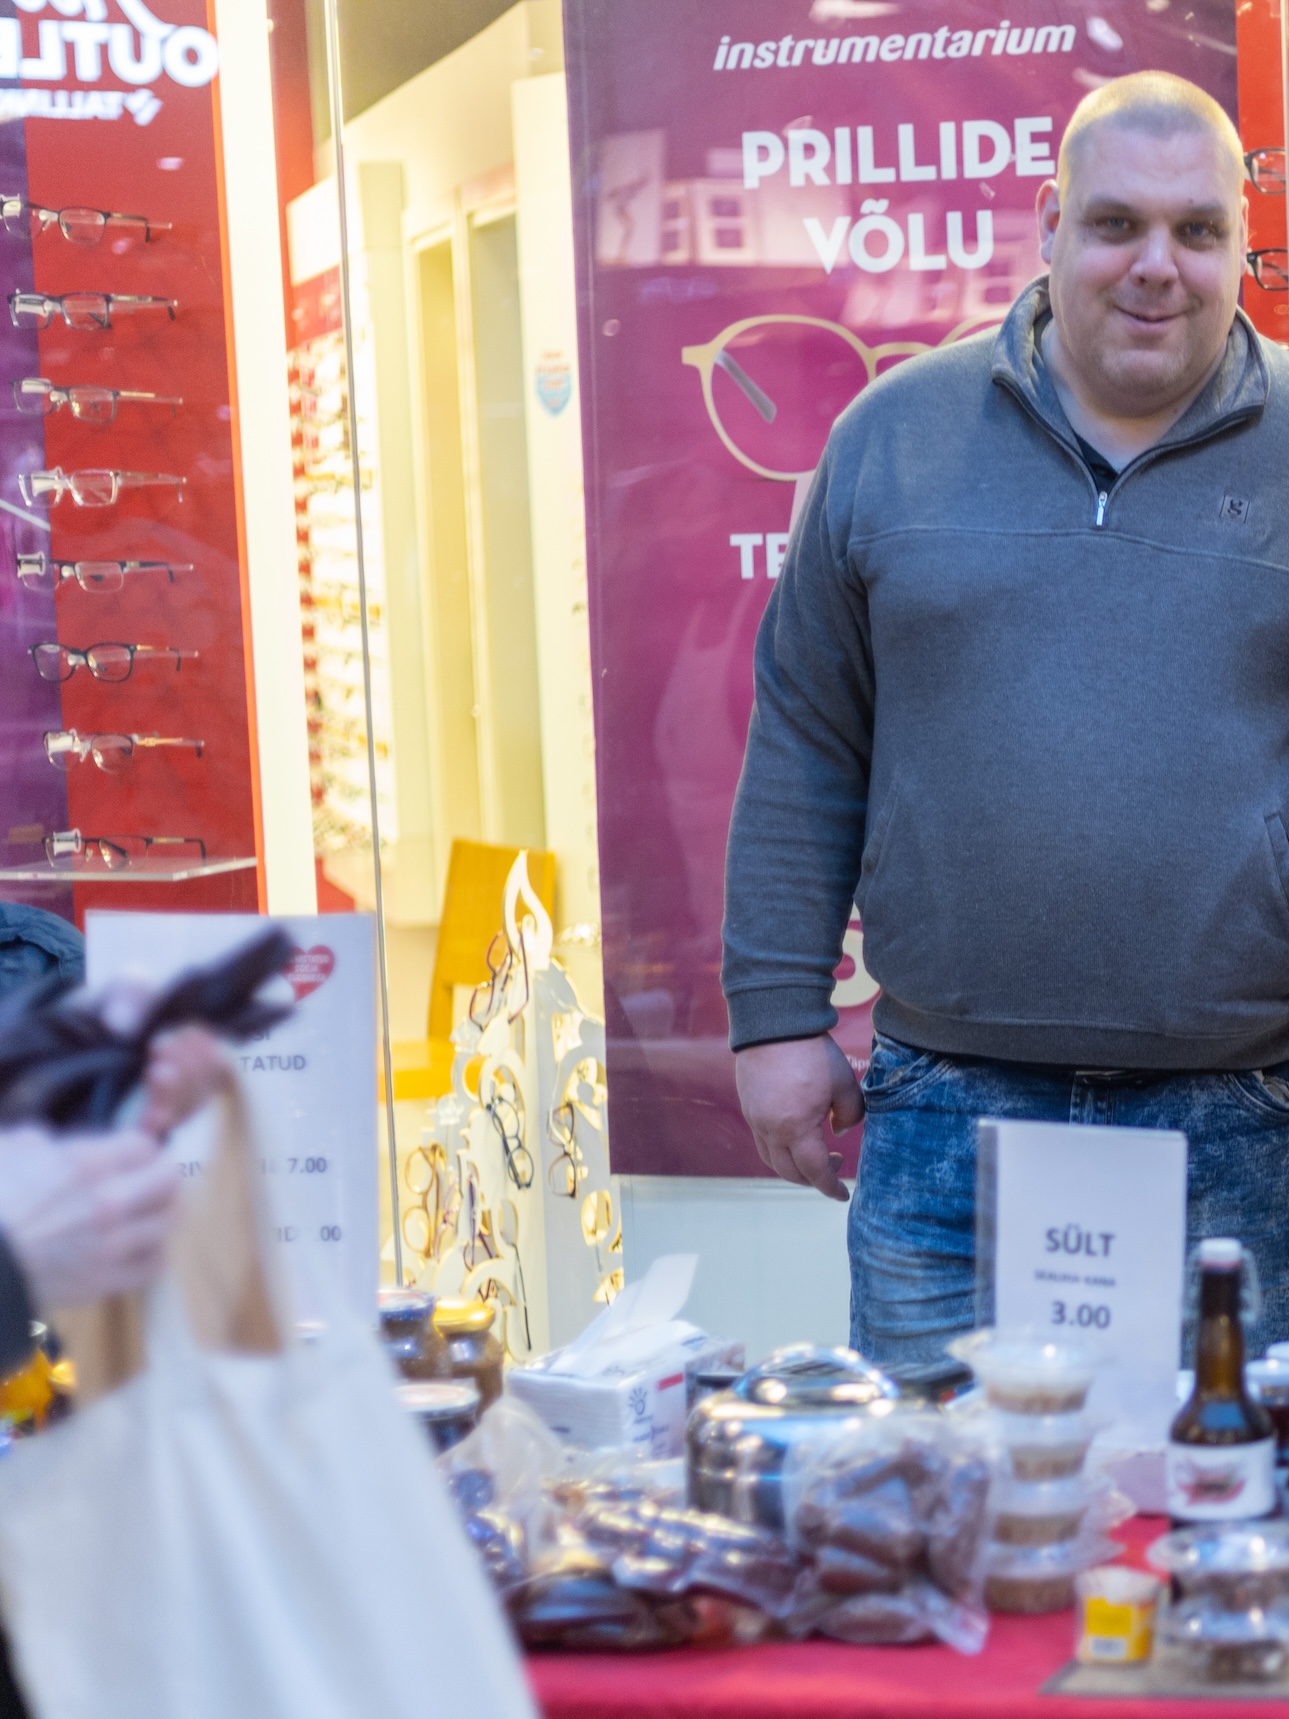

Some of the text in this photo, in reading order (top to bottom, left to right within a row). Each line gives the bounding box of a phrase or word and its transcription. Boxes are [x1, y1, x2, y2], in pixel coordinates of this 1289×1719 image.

[713, 20, 1076, 71] instrumentarium
[741, 116, 1055, 189] PRILLIDE
[803, 198, 995, 275] VÕLU
[1045, 1223, 1115, 1257] SÜLT
[1051, 1299, 1112, 1329] 3.00
